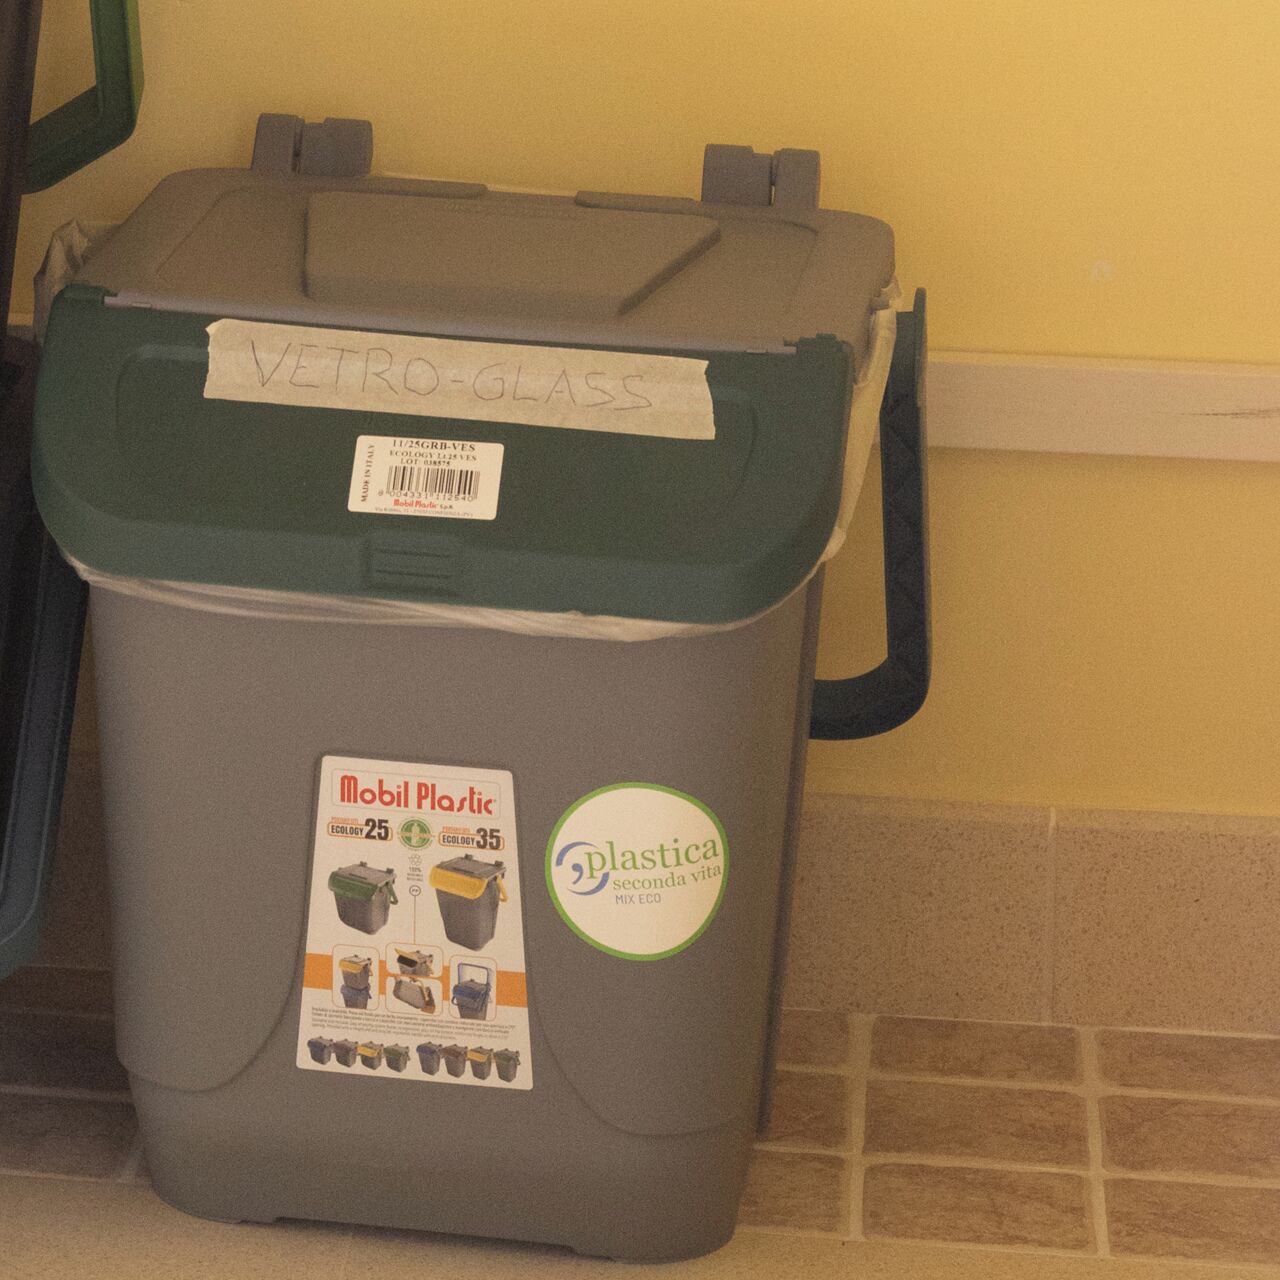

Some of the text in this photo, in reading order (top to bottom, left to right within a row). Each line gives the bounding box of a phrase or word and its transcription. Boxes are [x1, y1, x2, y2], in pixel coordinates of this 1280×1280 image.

[390, 450, 435, 459] ECOLOGY
[393, 498, 414, 507] Mobil
[340, 775, 494, 816] Mobil Plastic
[331, 825, 364, 837] ECOLOGY
[365, 818, 389, 841] 25
[442, 834, 476, 846] ECOLOGY
[476, 827, 501, 850] 35
[584, 838, 719, 880] plastica
[613, 864, 721, 891] seconda vita
[615, 893, 662, 905] MIX ECO
